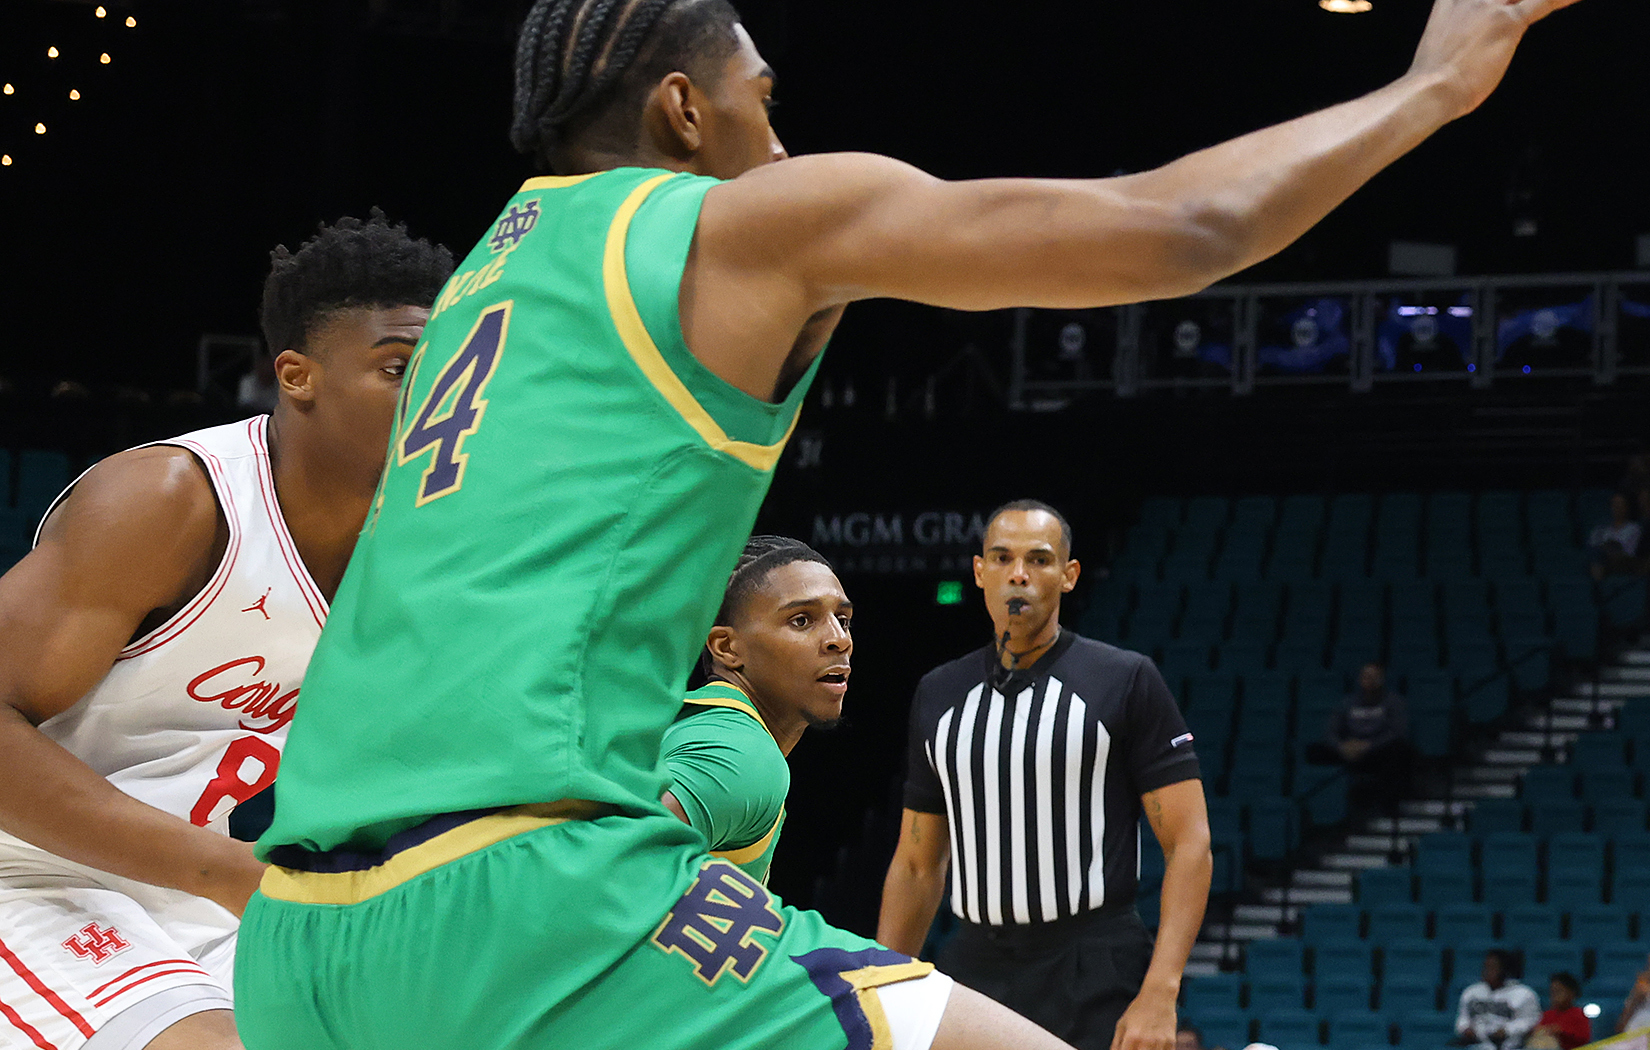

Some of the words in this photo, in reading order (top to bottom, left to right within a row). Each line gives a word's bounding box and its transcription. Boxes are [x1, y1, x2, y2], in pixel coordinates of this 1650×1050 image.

[366, 300, 514, 538] 4
[811, 511, 903, 548] MGM
[912, 511, 984, 546] GRA
[186, 655, 299, 733] Coug
